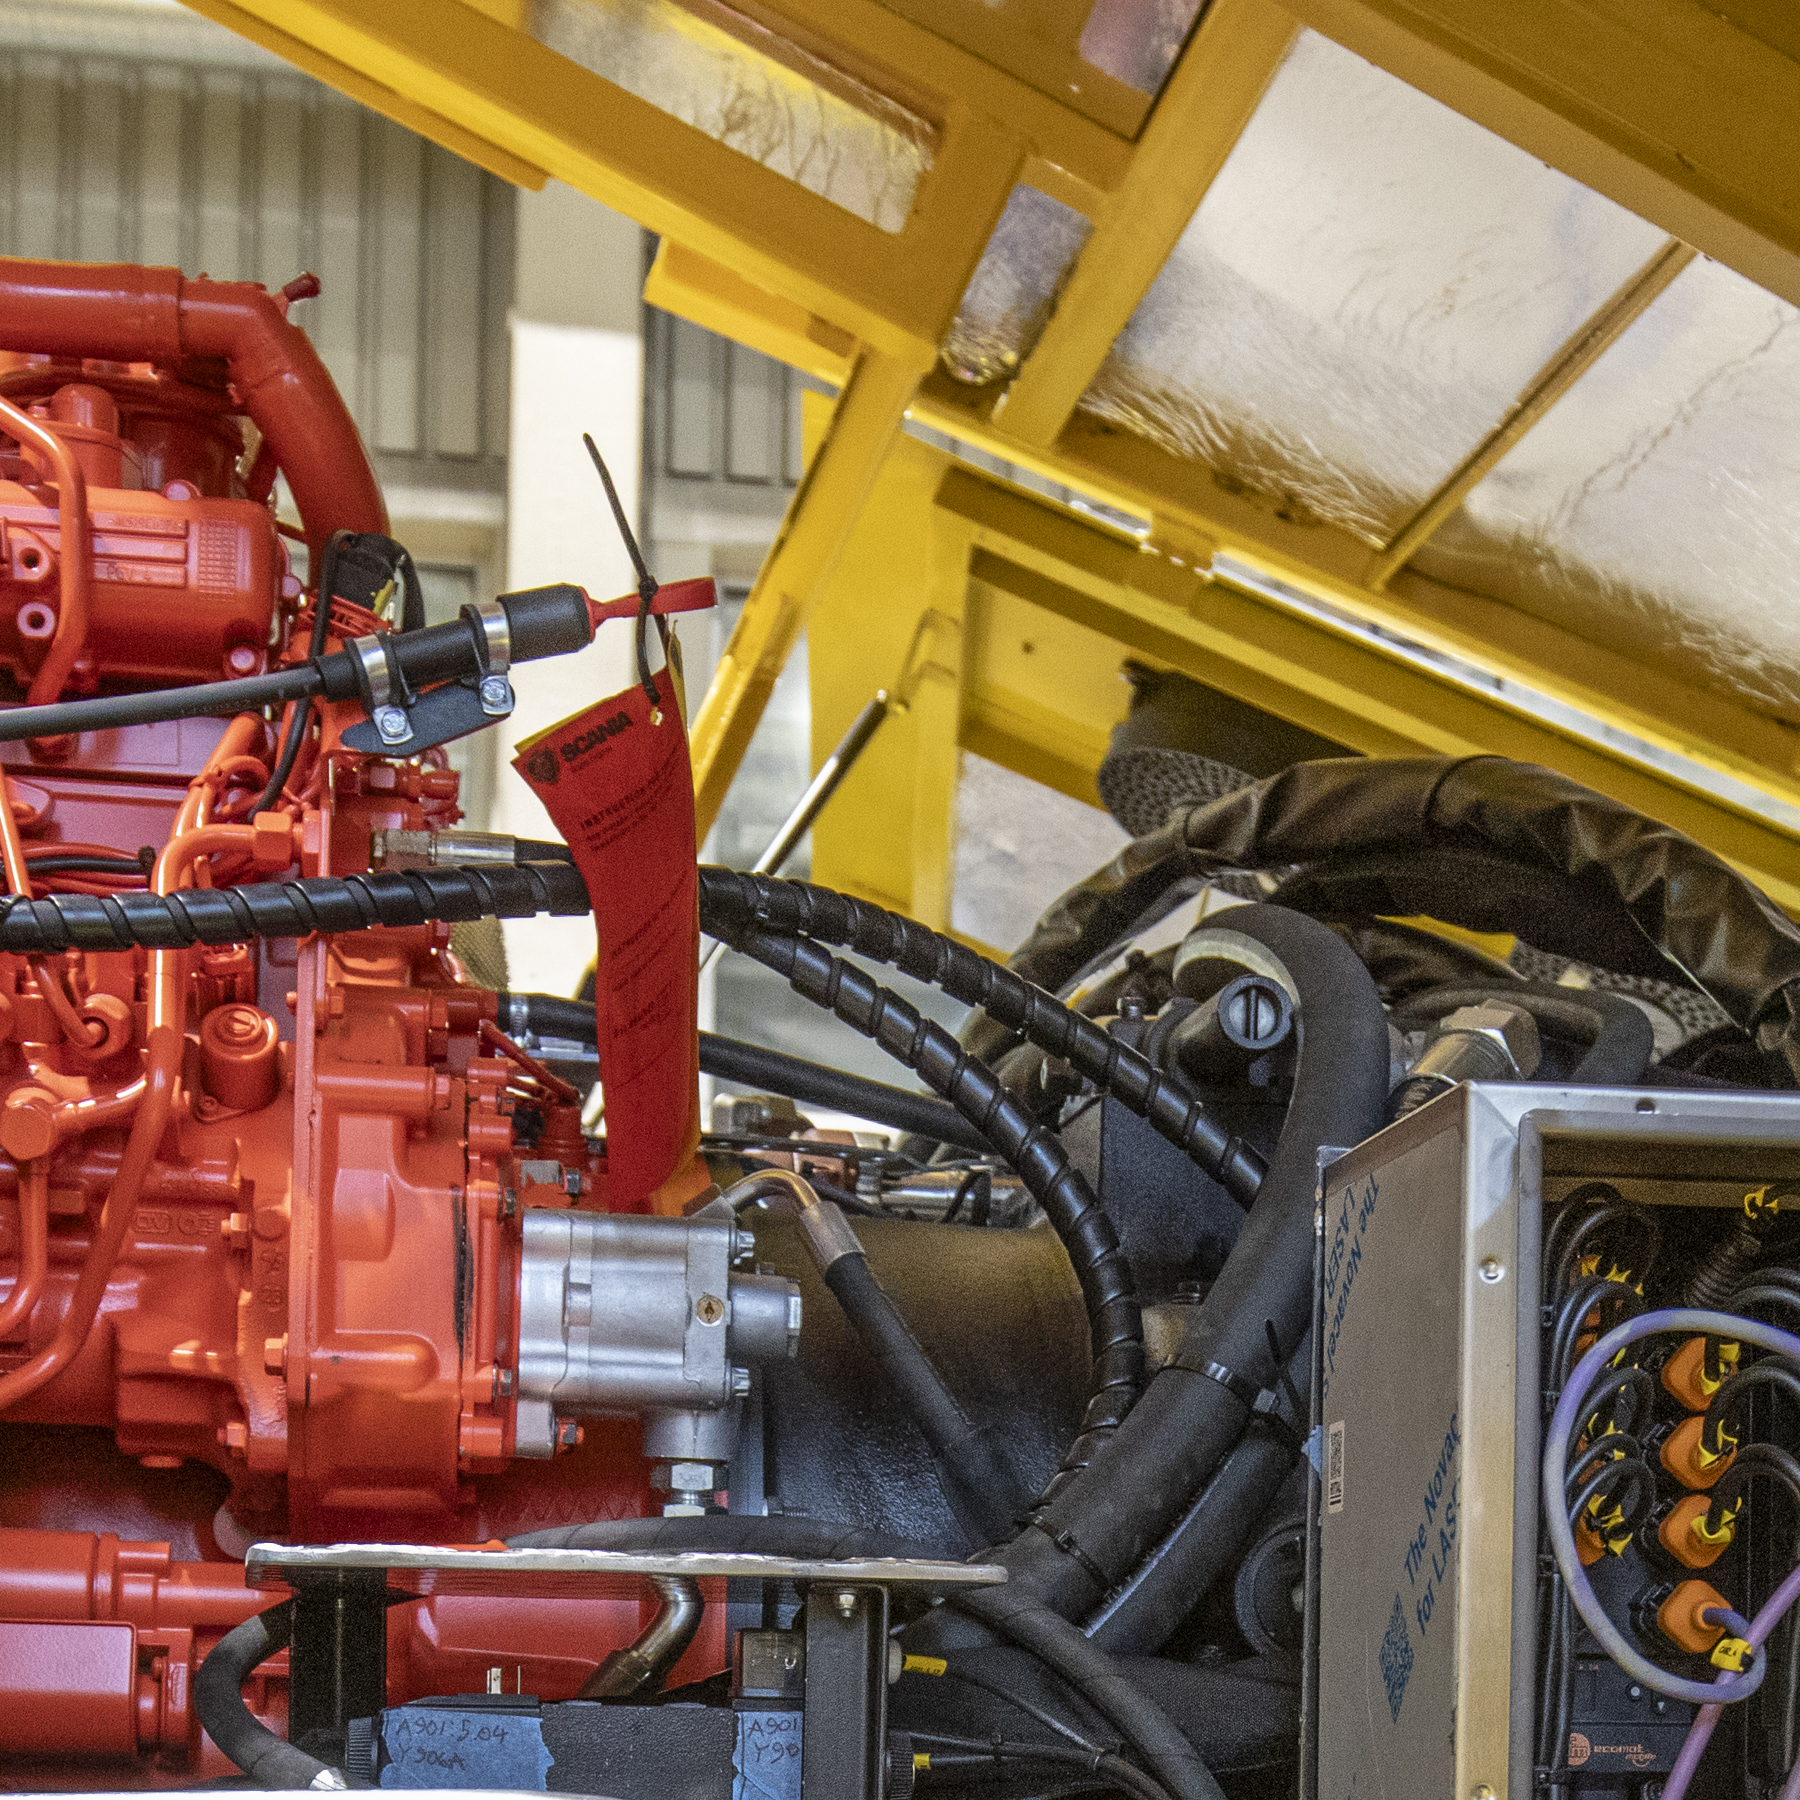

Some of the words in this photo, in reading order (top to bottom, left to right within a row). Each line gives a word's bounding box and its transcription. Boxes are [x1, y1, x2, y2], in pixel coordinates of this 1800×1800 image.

[560, 711, 633, 763] SCANIA
[1360, 1174, 1380, 1235] The
[1330, 1243, 1364, 1374] Novacel
[1404, 1522, 1428, 1585] The
[1415, 1577, 1437, 1638] for
[747, 1716, 798, 1738] A901
[1593, 1743, 1645, 1754] ecomat
